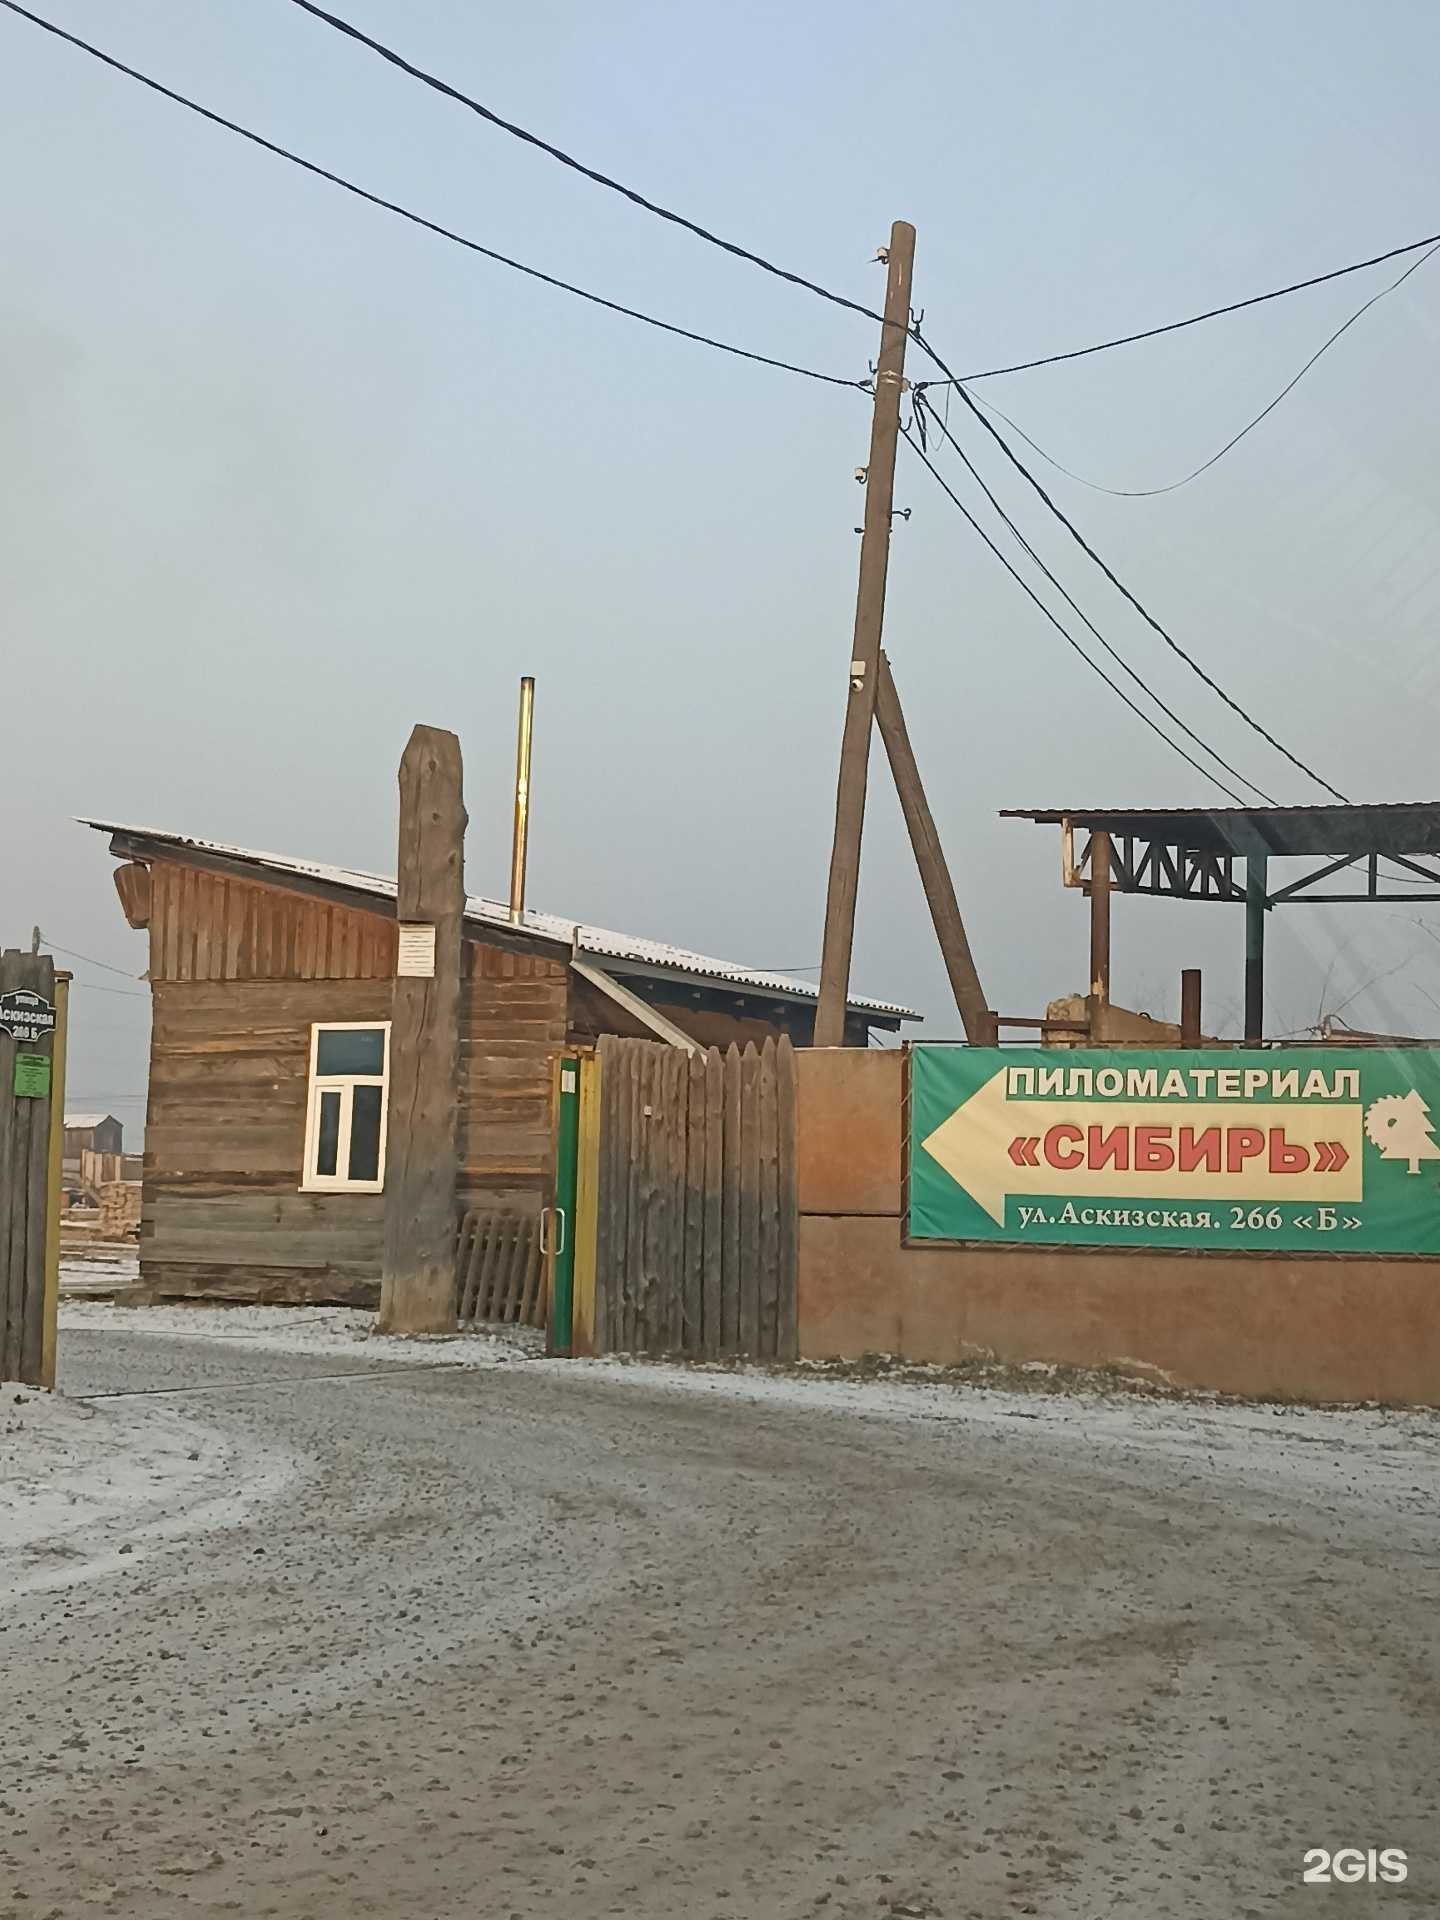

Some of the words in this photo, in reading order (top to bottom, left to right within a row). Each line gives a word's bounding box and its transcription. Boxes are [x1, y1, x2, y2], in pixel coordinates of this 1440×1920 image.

[1008, 1067, 1360, 1098] ПИЛОМАТЕРИАЛ
[1008, 1124, 1350, 1174] «СИБИРЬ»
[1230, 1207, 1283, 1230] 266
